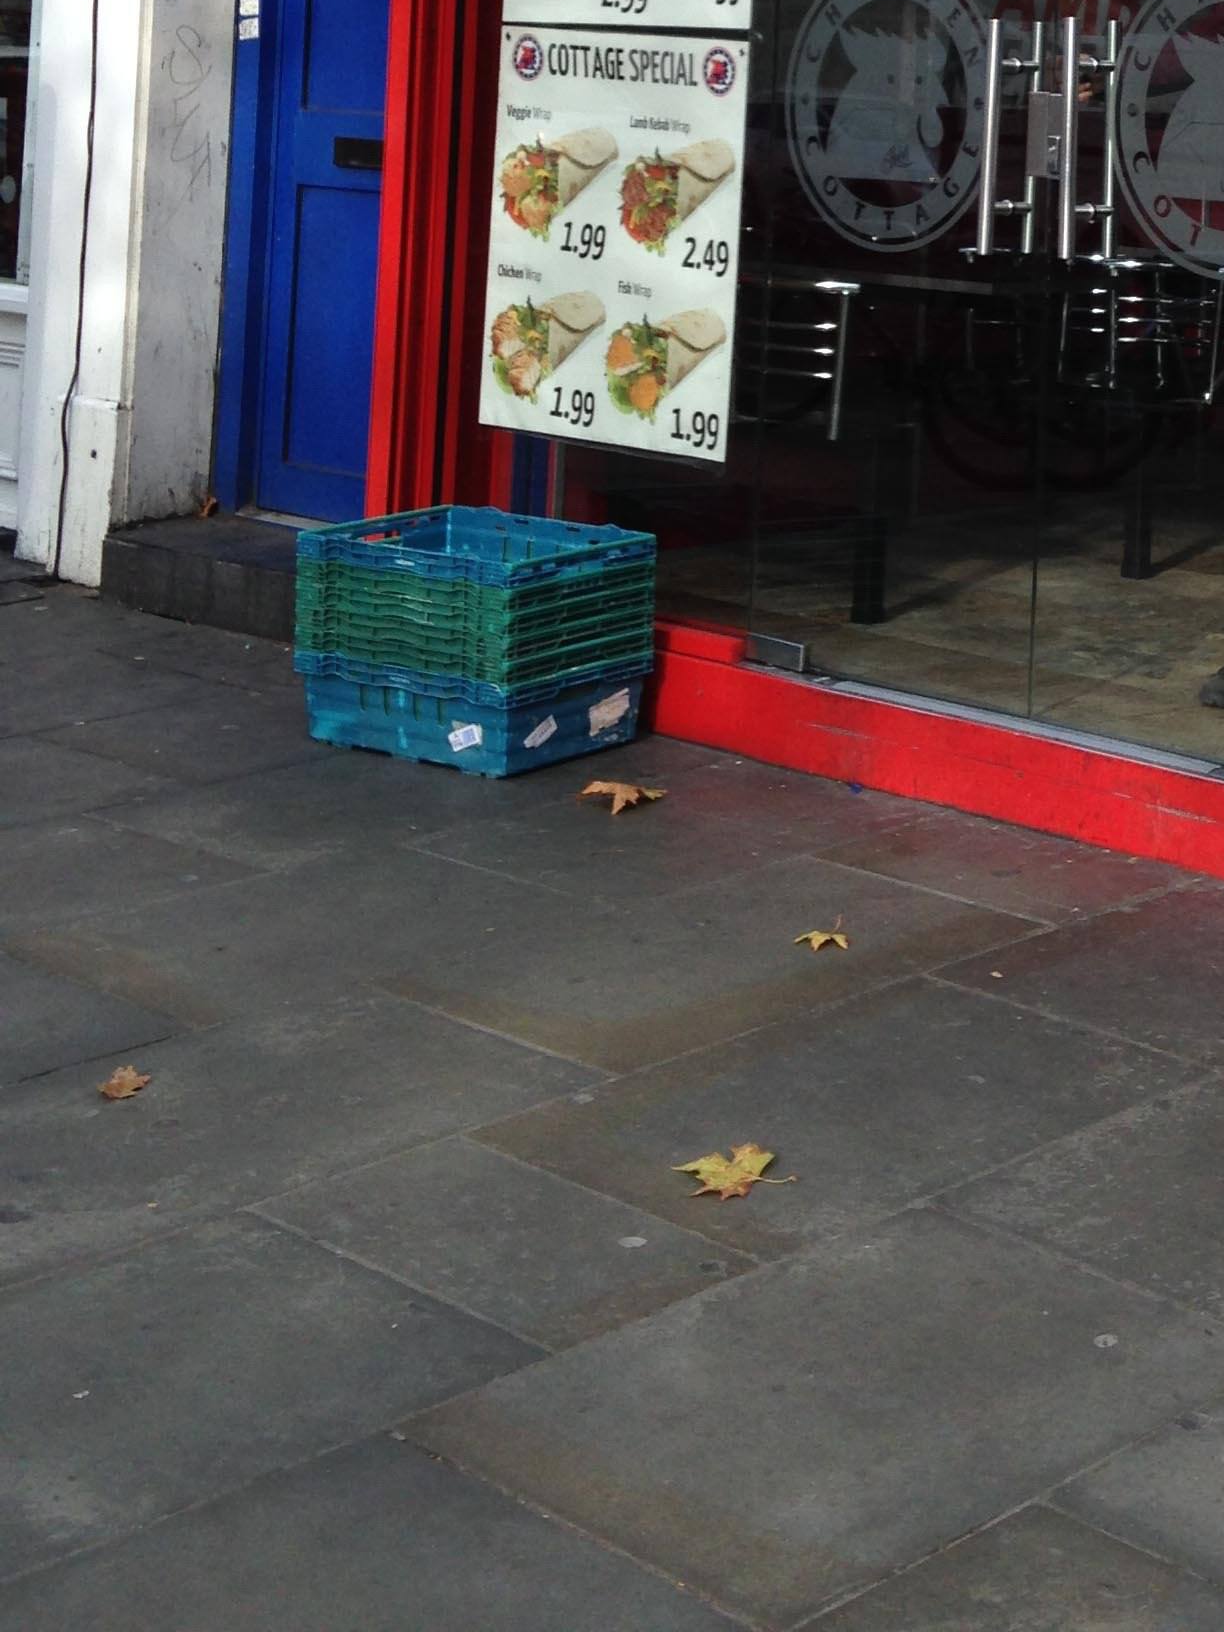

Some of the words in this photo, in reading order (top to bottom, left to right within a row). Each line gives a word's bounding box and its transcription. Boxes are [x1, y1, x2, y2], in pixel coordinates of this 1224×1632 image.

[548, 44, 625, 80] COTTAGE
[629, 49, 698, 86] SPECIAL
[506, 105, 531, 121] Veggie
[533, 106, 552, 122] Wrap
[630, 116, 648, 129] Lamb
[671, 119, 691, 135] Wrap
[806, 135, 979, 231] COTTAGE
[560, 222, 606, 260] 1.99
[681, 237, 729, 277] 2.49
[550, 387, 595, 428] 1.99
[671, 408, 719, 450] 1.99
